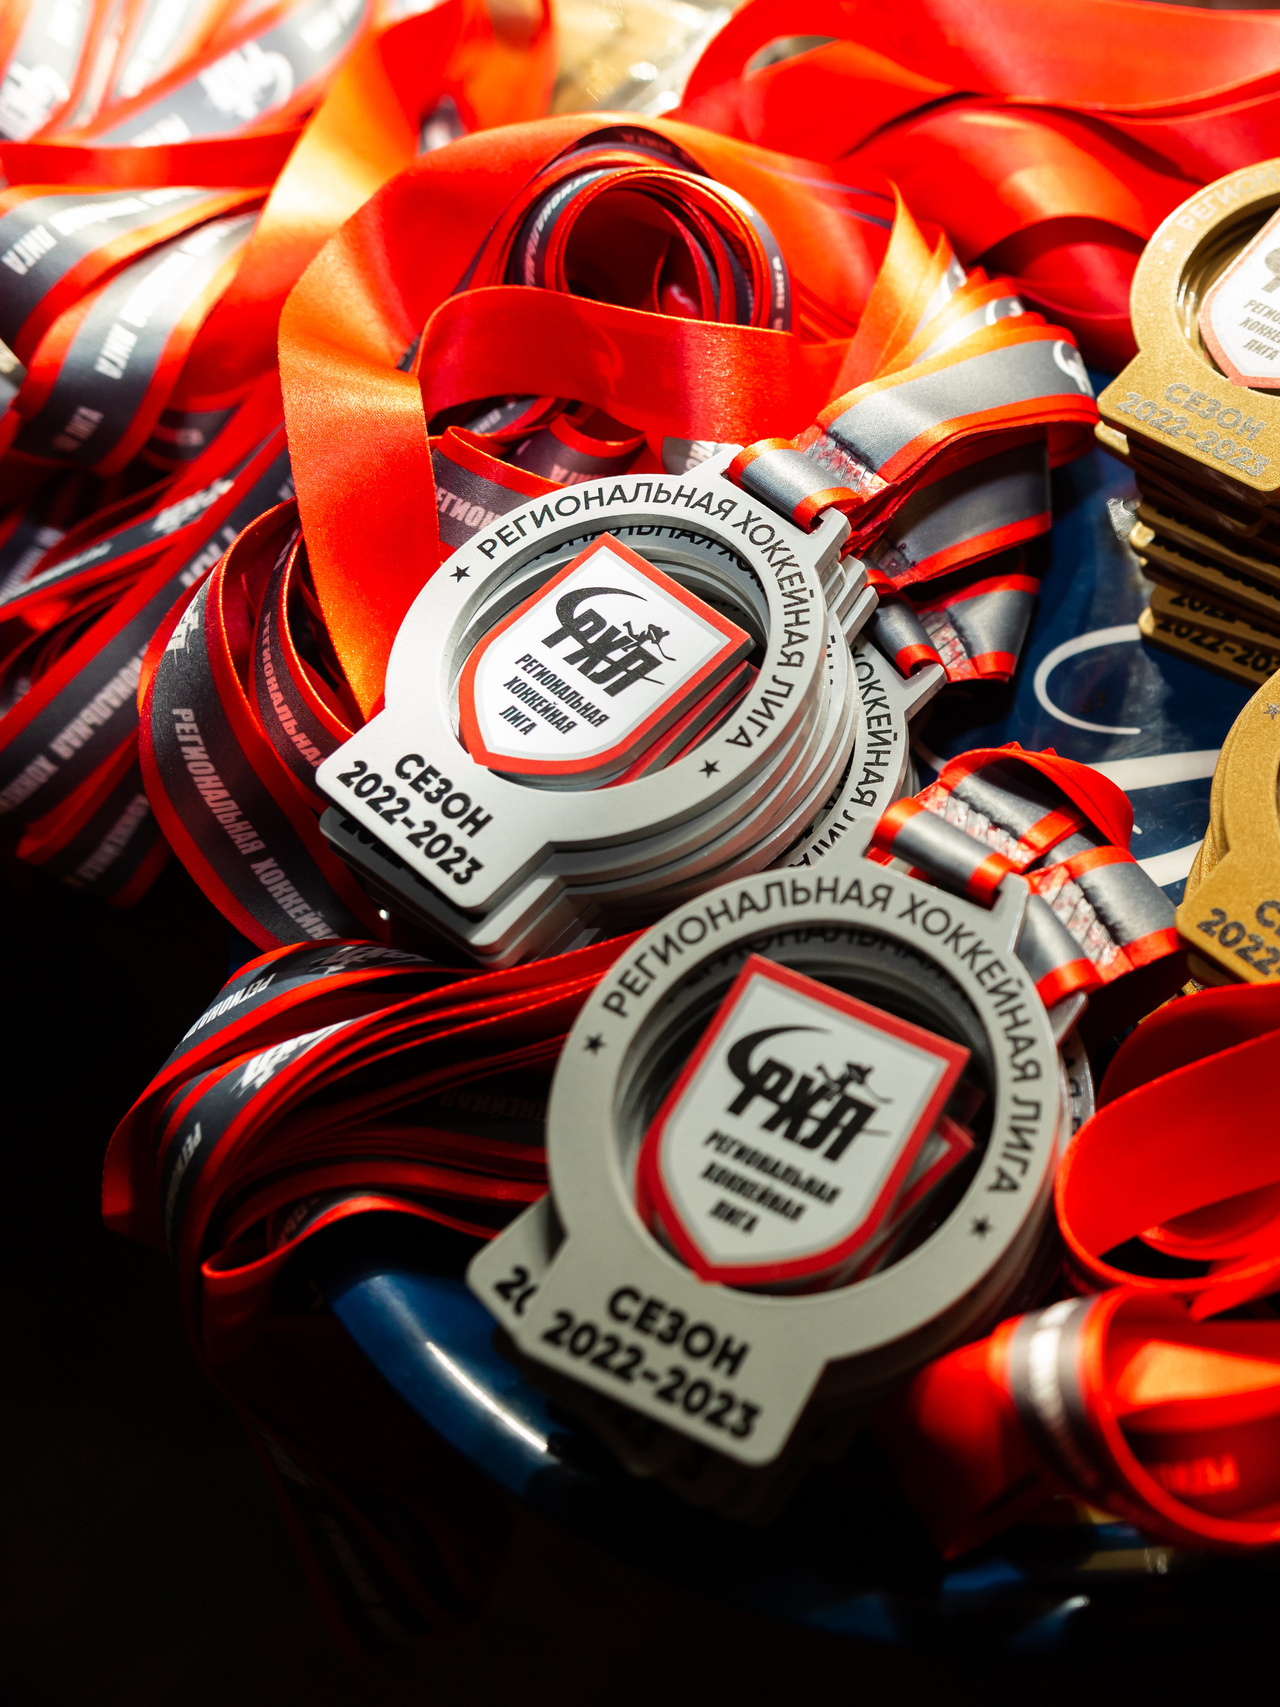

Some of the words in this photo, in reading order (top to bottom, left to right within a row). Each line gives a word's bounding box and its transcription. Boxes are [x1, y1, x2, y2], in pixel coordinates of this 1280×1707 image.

[1243, 338, 1280, 361] ЛИГА
[1115, 391, 1272, 477] 2022-2023
[1163, 382, 1267, 441] СЕЗОН
[476, 482, 738, 560] РЕГИОНАЛЬНАЯ
[731, 509, 815, 668] ХОККЕЙНАЯ
[498, 705, 538, 736] ЛИГА
[502, 675, 578, 735] ХОККЕЙНАЯ
[514, 653, 611, 728] РЕГИОНАЛЬНАЯ
[725, 674, 795, 749] ЛИГА
[172, 708, 266, 855] РЕГИОНАЛЬНАЯ
[336, 760, 485, 885] 2022-2023
[395, 753, 494, 838] СЕЗОН
[601, 876, 894, 1018] РЕГИОНАЛЬНАЯ
[897, 892, 1042, 1083] ХОККЕЙНАЯ
[986, 1096, 1042, 1195] ЛИГА
[606, 1285, 751, 1379] СЕЗОН
[540, 1309, 762, 1441] 2022-2023
